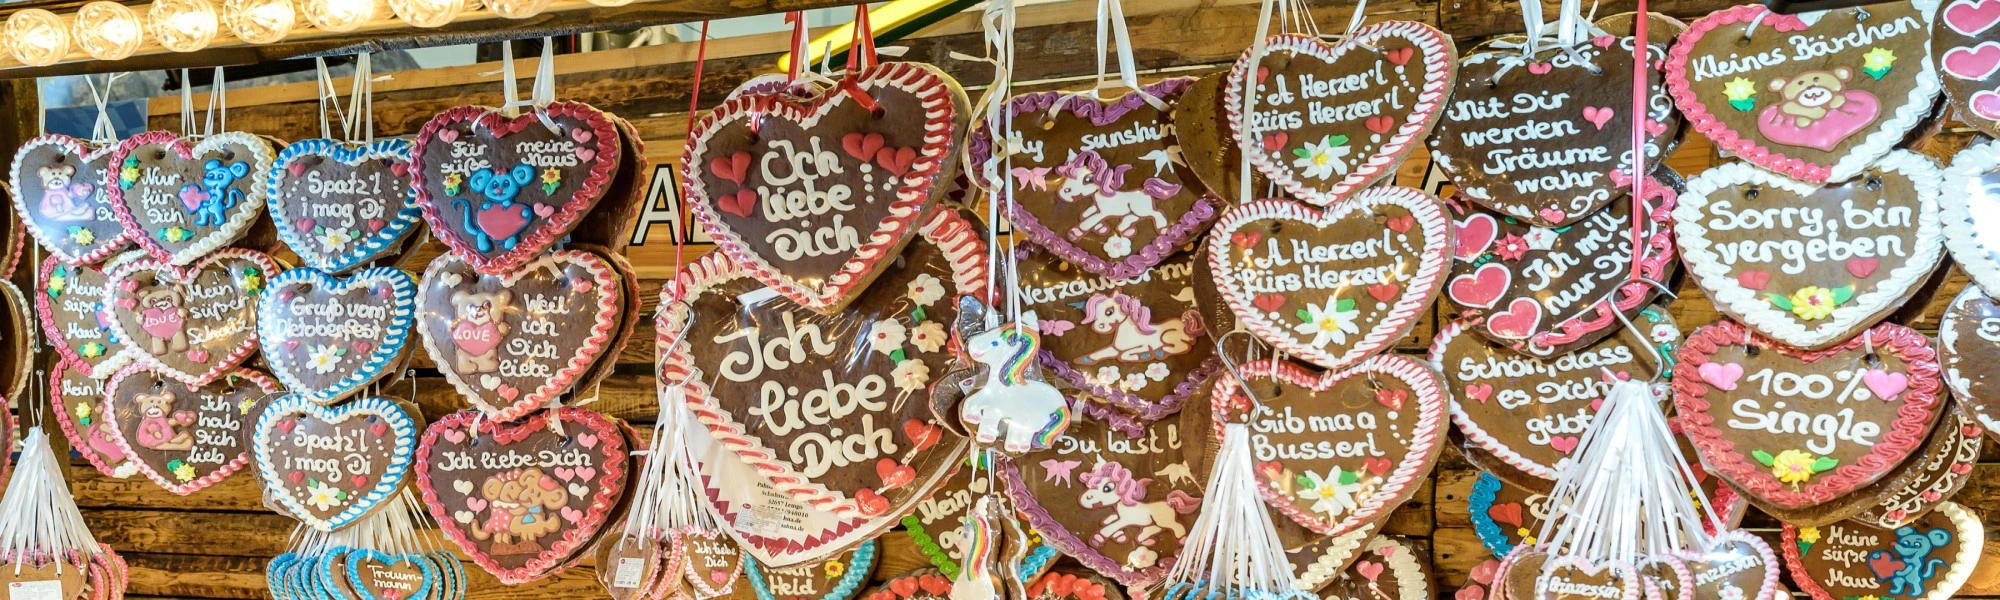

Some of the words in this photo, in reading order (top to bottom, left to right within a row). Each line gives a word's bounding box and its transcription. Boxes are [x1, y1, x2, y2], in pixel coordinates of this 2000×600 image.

[1691, 47, 1787, 82] Kleines
[1788, 14, 1922, 61] Bärchen
[1447, 96, 1510, 122] Mit
[1511, 90, 1571, 114] Dir
[1080, 119, 1177, 151] sunshin
[1251, 109, 1303, 141] fürs
[1461, 119, 1581, 147] werden
[450, 140, 488, 157] Für
[515, 139, 577, 154] meine
[440, 158, 492, 178] süße
[520, 152, 578, 168] Maus
[760, 135, 845, 186] Ich
[1482, 145, 1612, 175] Träume
[141, 166, 181, 187] Nur
[1513, 169, 1605, 195] wahr
[141, 186, 175, 210] für
[756, 179, 857, 222] liebe
[146, 207, 185, 225] Dich
[312, 203, 356, 228] mog
[358, 197, 387, 220] Di
[1708, 200, 1839, 237] Sorry,
[1841, 198, 1912, 230] bin
[765, 213, 864, 261] Dich
[1713, 228, 1906, 275] vergeben
[1522, 251, 1580, 291] Ich
[185, 280, 234, 303] Mein
[1239, 268, 1302, 301] fürs
[1544, 271, 1597, 316] nur
[290, 296, 344, 323] Gruß
[346, 302, 387, 322] vom
[523, 293, 570, 315] Weil
[144, 312, 178, 328] LOVE
[520, 318, 560, 337] ich
[453, 328, 491, 342] LOVE
[713, 310, 837, 382] Ich
[505, 338, 561, 359] Dich
[1555, 345, 1633, 373] dass
[498, 359, 554, 379] liebe
[1496, 388, 1532, 410] es
[1536, 376, 1612, 404] Dich
[1745, 367, 1873, 405] 100%
[200, 395, 231, 412] Ich
[747, 368, 888, 437] liebe
[198, 412, 240, 431] hab
[1250, 405, 1306, 434] Gib
[1308, 412, 1355, 433] ma
[1356, 411, 1378, 431] a
[1526, 407, 1594, 446] gibt
[1727, 397, 1881, 456] Single
[195, 430, 238, 448] Dich
[788, 412, 899, 479] Dich
[1056, 435, 1102, 454] Du
[1251, 432, 1386, 461] Busserl
[187, 447, 226, 464] lieb
[295, 456, 343, 483] mog
[344, 453, 372, 475] Di
[437, 451, 477, 471] Ich
[480, 449, 537, 470] liebe
[538, 448, 593, 468] Dich
[693, 540, 713, 555] Ich
[1826, 525, 1880, 547] Meine
[705, 555, 729, 568] Dich
[1821, 545, 1869, 568] süße
[372, 578, 412, 591] mann
[768, 574, 818, 596] Held
[1824, 567, 1881, 590] Maus
